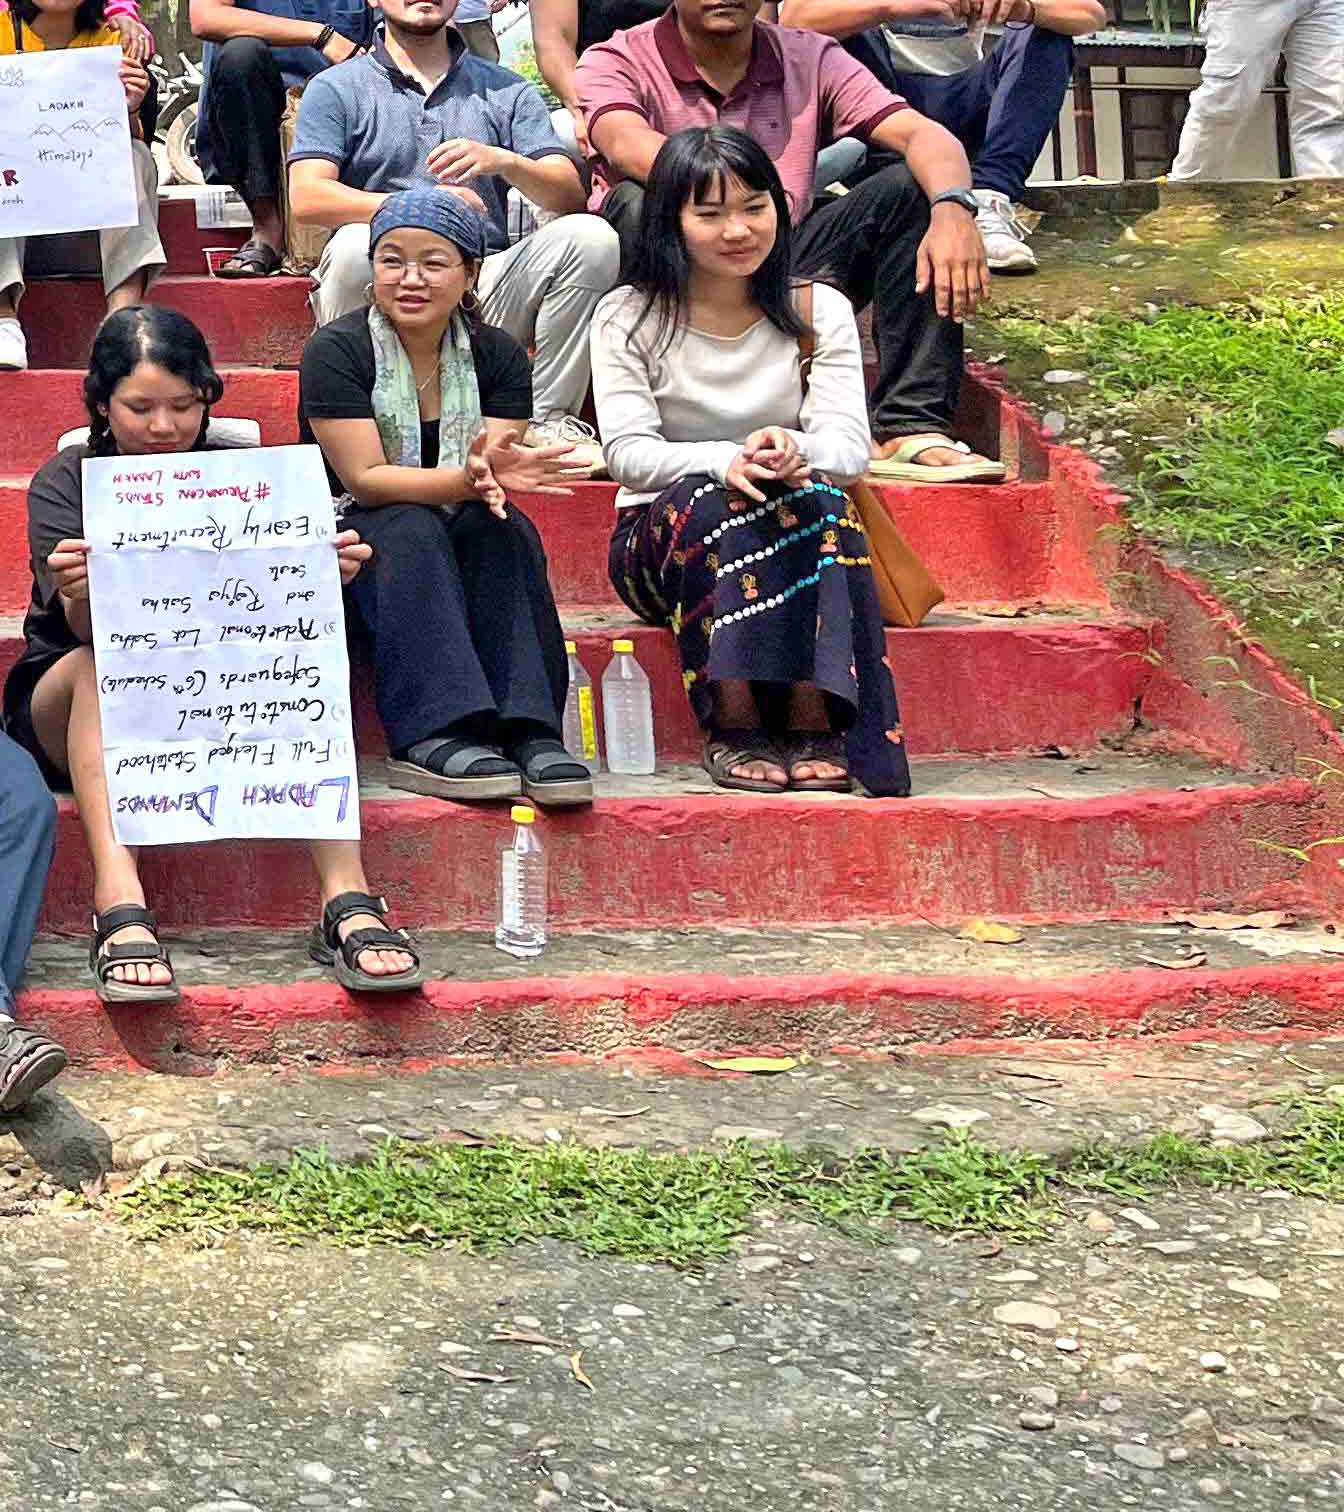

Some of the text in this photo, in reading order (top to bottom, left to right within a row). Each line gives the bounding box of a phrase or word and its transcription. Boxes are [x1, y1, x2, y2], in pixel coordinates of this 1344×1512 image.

[38, 100, 85, 113] LADAKH
[112, 515, 232, 552] Recruitment
[242, 505, 311, 544] Early
[286, 590, 316, 605] and
[220, 616, 319, 644] Additional
[220, 654, 321, 690] Safeguards
[116, 750, 197, 775] Statehood
[208, 733, 276, 766] Fledged
[291, 739, 331, 763] Full
[116, 775, 351, 826] LADAKH DEMANDS
